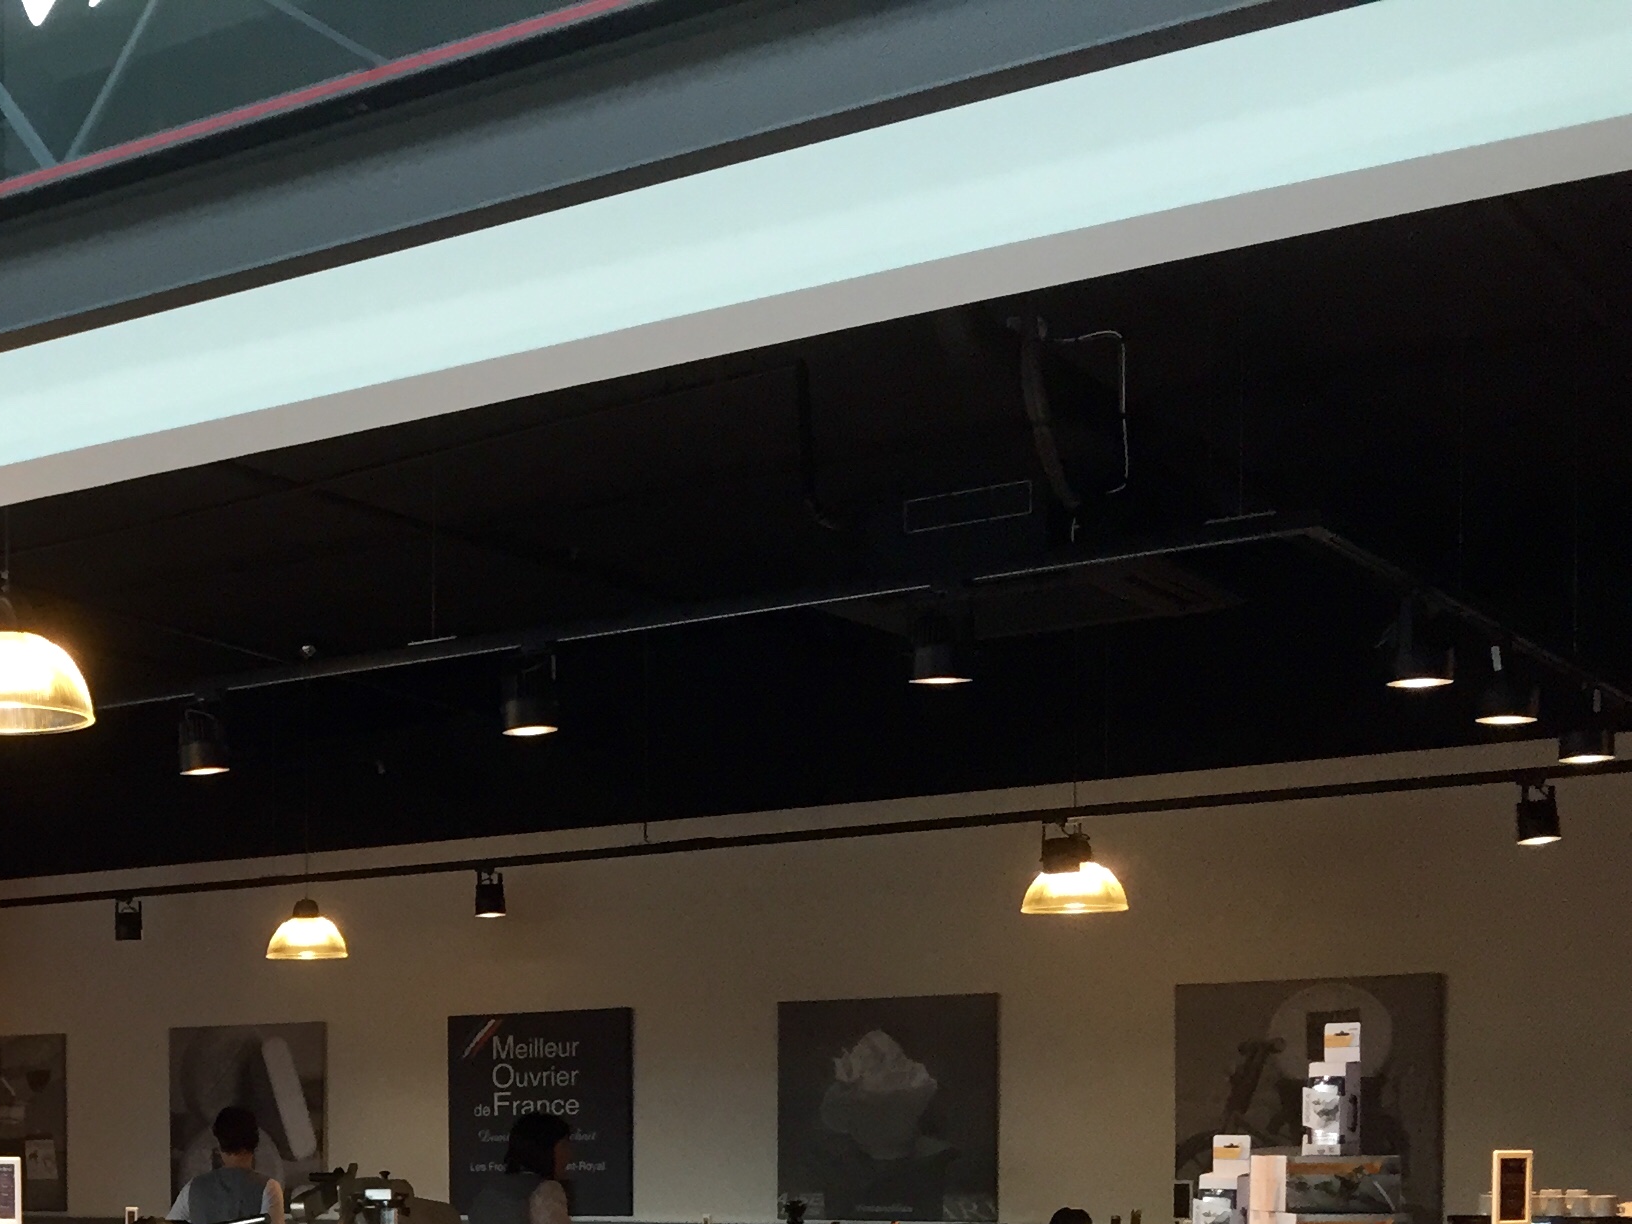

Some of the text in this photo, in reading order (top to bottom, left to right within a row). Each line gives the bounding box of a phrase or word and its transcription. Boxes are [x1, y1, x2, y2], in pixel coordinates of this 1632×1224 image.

[492, 1034, 579, 1060] Meilleur
[492, 1063, 579, 1089] Ouvrier
[473, 1091, 580, 1117] de France
